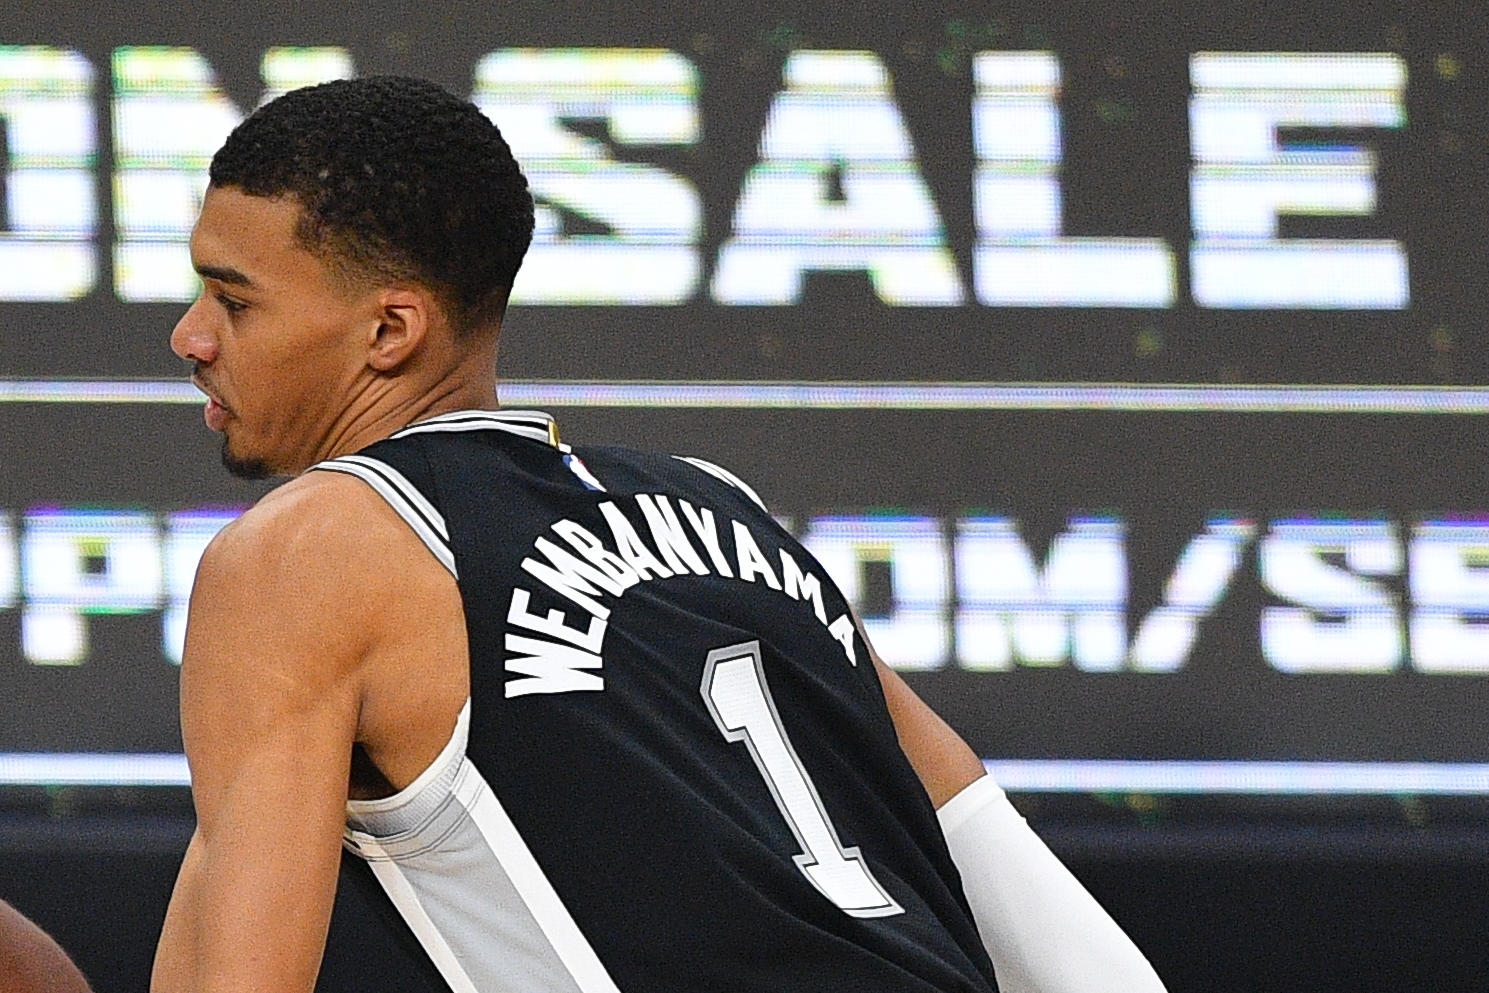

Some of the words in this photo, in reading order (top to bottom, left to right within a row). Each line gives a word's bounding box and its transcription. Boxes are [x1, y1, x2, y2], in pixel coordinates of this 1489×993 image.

[470, 46, 1411, 310] SALE
[504, 493, 859, 699] WEMBANYAMA
[699, 639, 906, 919] 1
